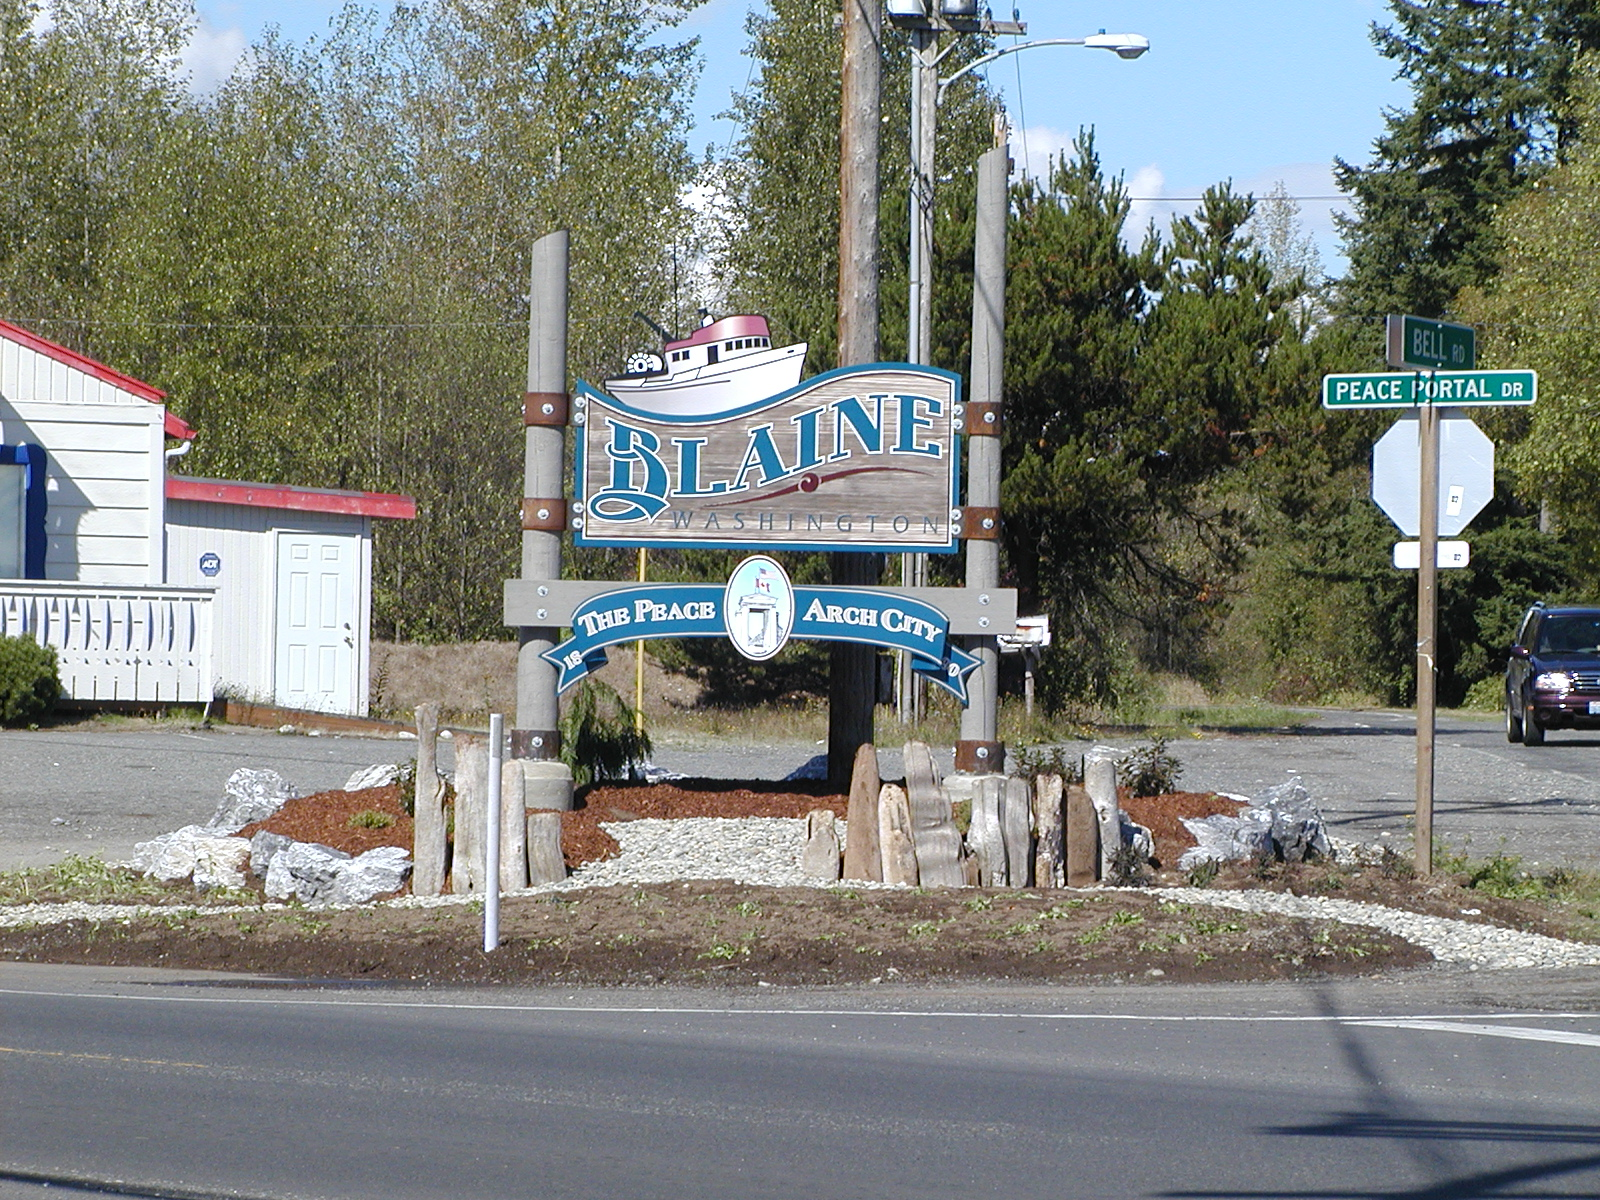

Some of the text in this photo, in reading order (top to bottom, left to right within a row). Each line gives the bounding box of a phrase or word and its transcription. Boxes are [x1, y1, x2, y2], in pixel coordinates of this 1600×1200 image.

[1413, 328, 1465, 364] BELL RD
[1336, 378, 1524, 401] PEACE PORTAL DR
[587, 393, 944, 524] BLAINE
[672, 510, 940, 535] WASHINGTON
